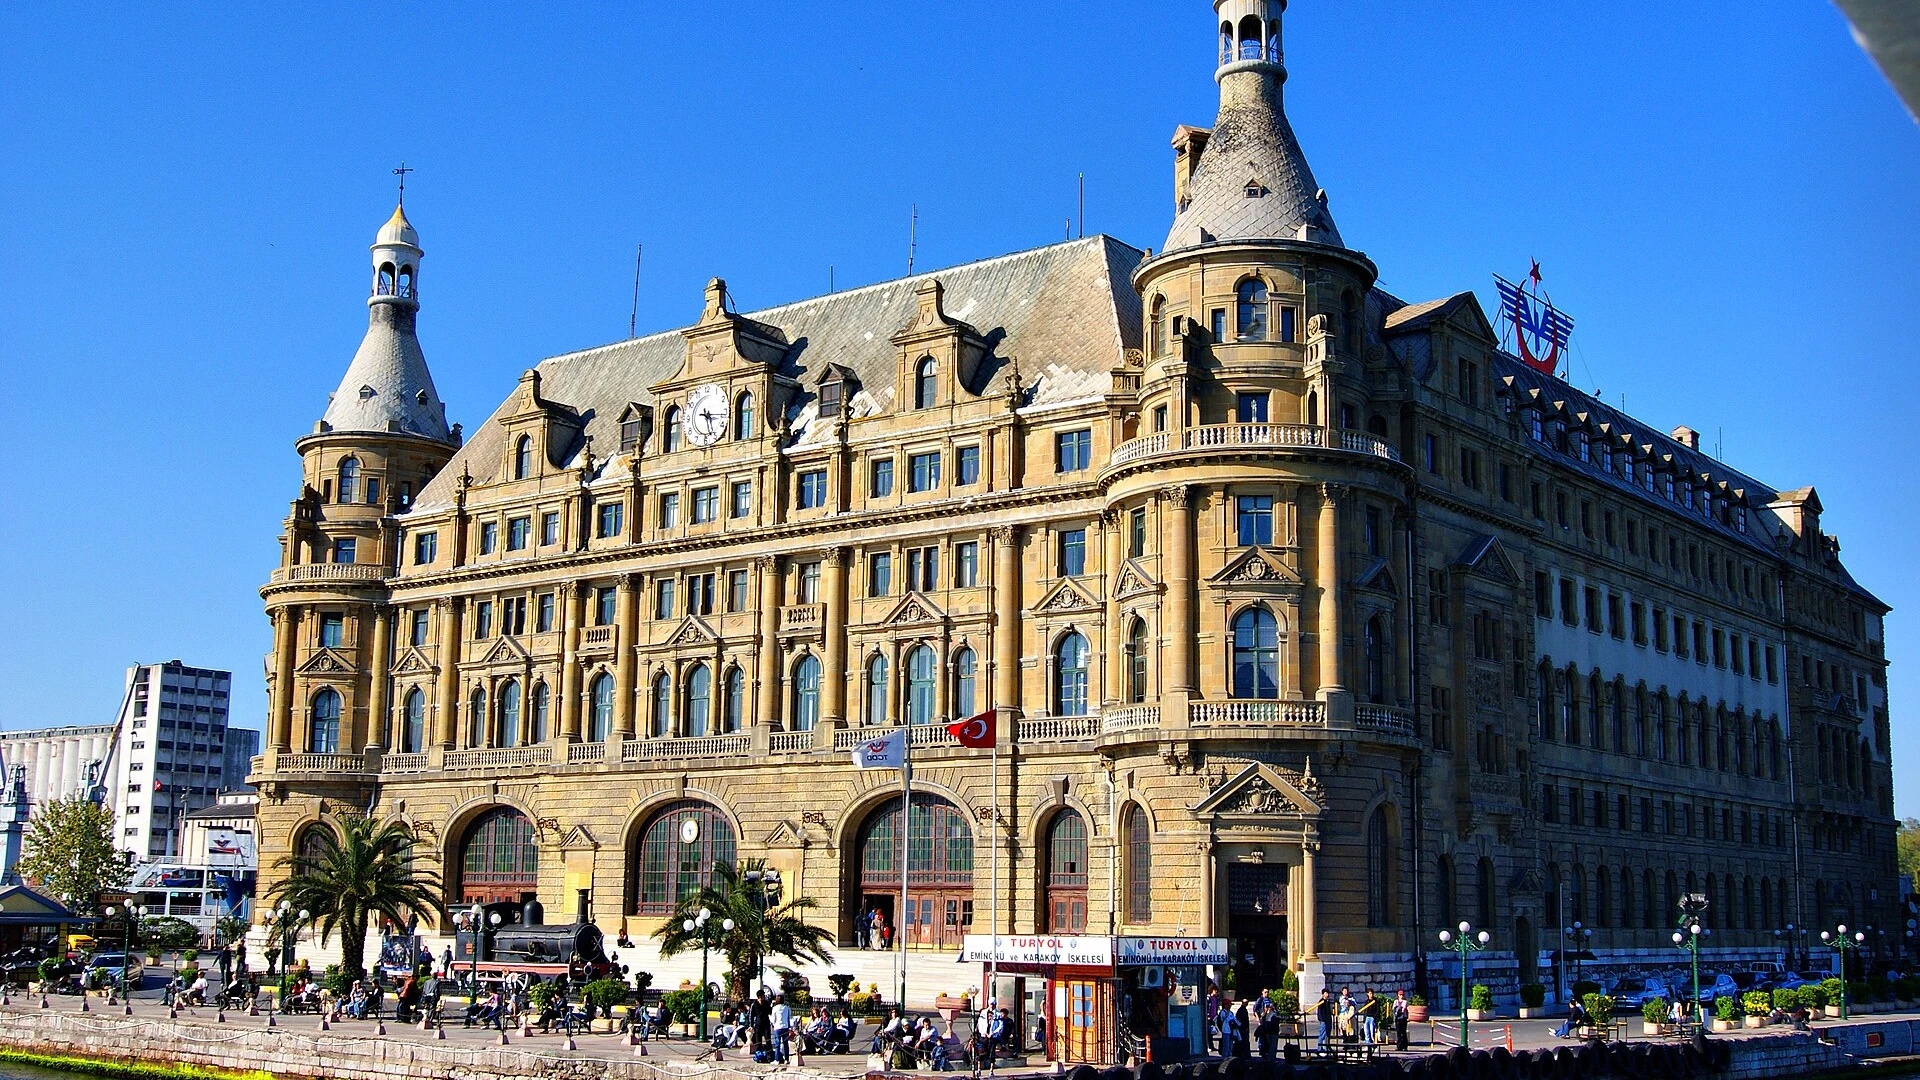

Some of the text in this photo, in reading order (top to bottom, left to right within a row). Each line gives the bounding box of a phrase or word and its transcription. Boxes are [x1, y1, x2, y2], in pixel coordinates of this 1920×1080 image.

[704, 385, 711, 394] 12
[721, 395, 726, 403] 2
[1010, 938, 1063, 949] TURYOL
[1149, 940, 1198, 950] TURYOL
[1009, 954, 1019, 962] ve
[1067, 952, 1104, 964] İSKELESİ
[1118, 953, 1152, 964] EMİNÖNÜ
[1162, 952, 1196, 964] KARAKÖY
